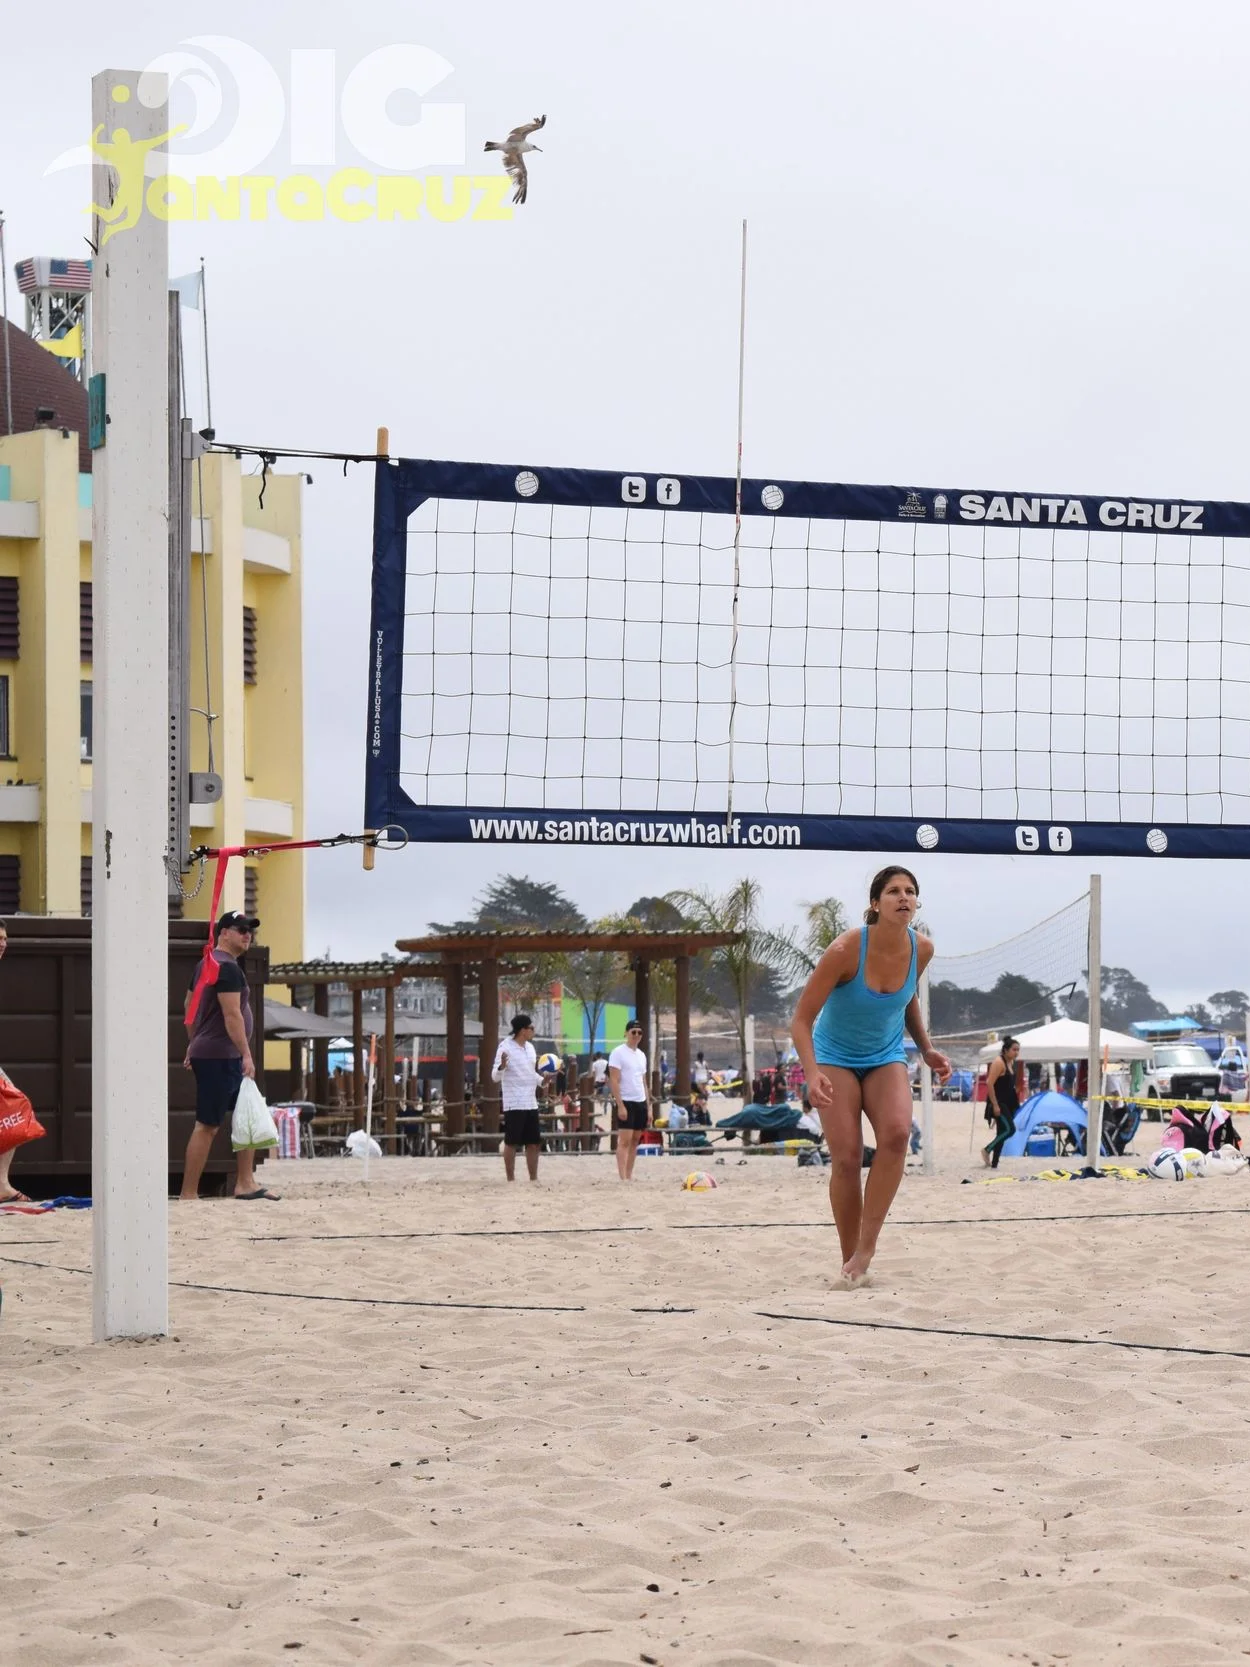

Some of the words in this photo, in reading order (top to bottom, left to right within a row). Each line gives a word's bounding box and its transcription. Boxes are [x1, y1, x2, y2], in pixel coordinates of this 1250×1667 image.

[959, 494, 1088, 525] SANTA
[1098, 500, 1204, 530] CRUZ
[469, 816, 801, 846] www.santacruzwharf.com
